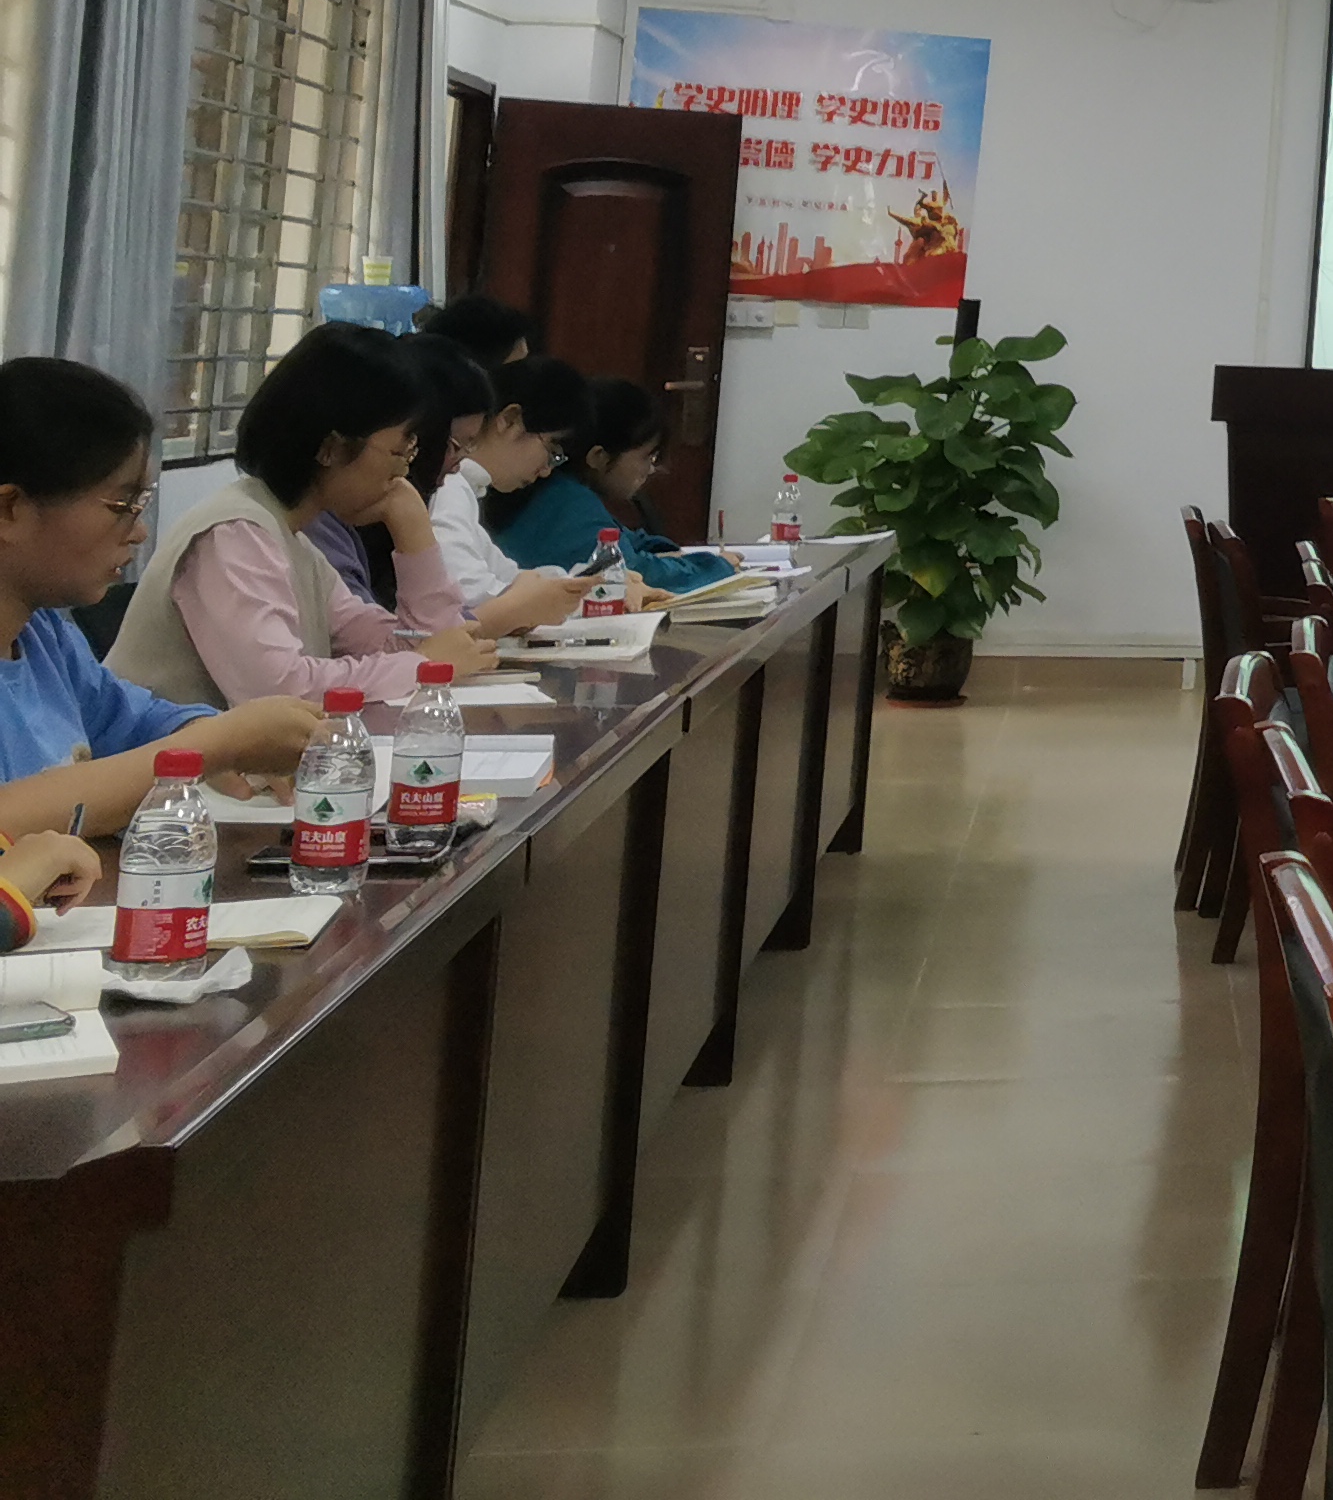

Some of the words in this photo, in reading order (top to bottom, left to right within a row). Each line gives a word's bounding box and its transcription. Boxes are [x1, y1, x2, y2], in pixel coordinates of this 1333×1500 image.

[816, 92, 943, 132] 学史增信
[811, 142, 937, 181] 学史力行
